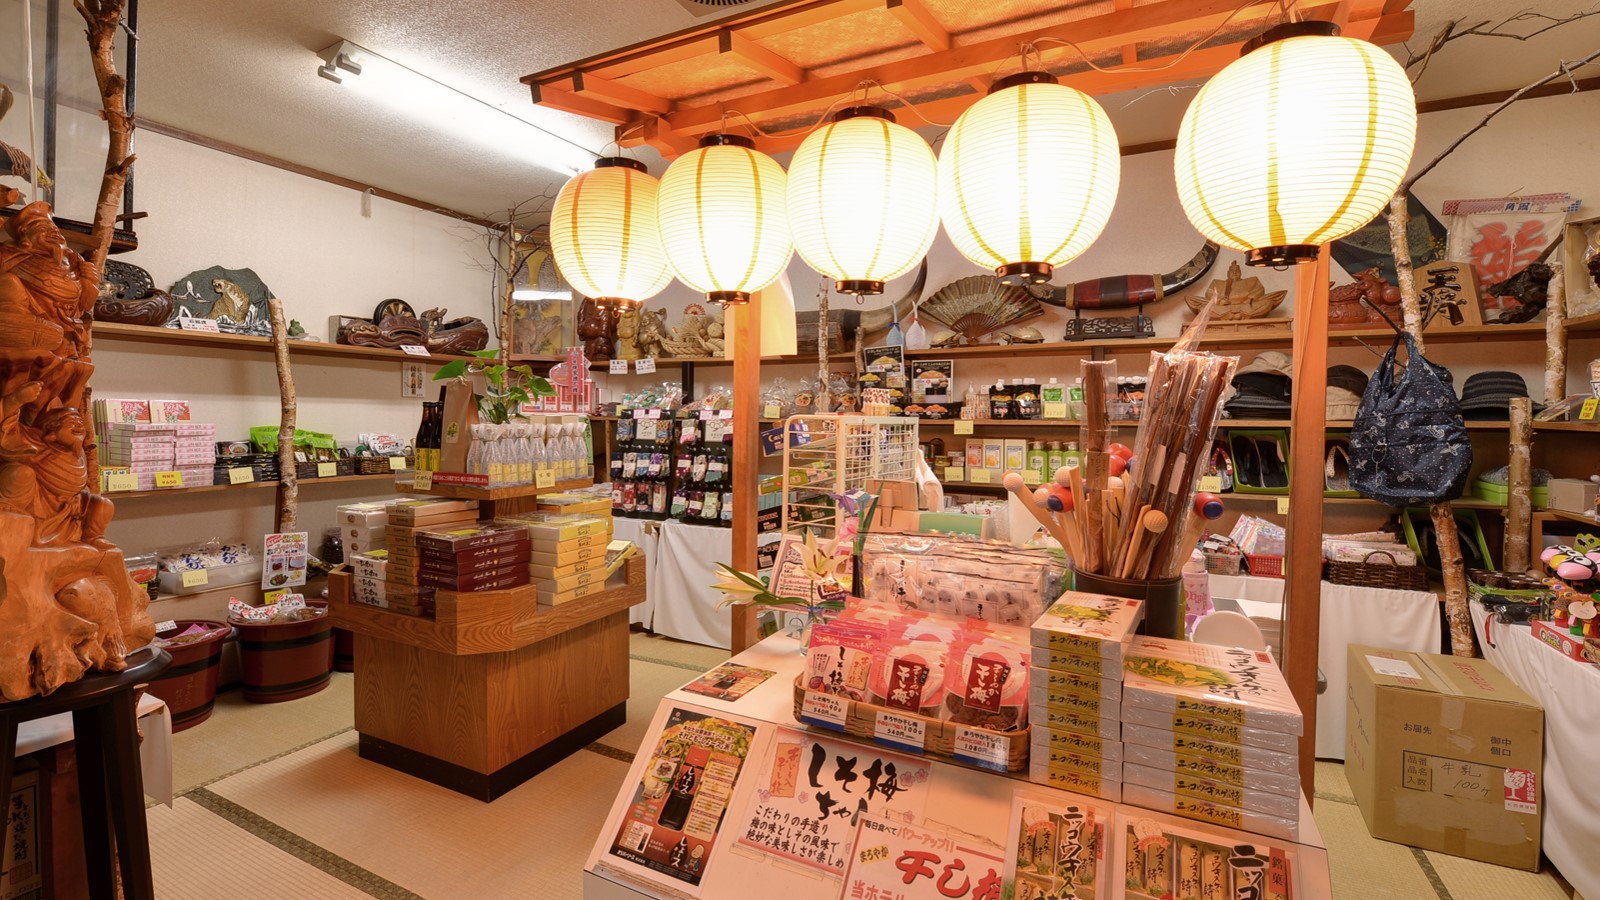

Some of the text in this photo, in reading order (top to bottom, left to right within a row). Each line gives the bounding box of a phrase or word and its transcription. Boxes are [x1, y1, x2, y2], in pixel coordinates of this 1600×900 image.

[891, 665, 910, 705] 干し梅
[970, 663, 990, 704] 干し梅
[1403, 723, 1432, 735] お届先
[1490, 735, 1512, 746] 御中
[1490, 746, 1511, 757] 個口
[808, 742, 908, 803] しそ梅
[1407, 765, 1428, 776] 品名
[1407, 775, 1427, 787] 入数
[755, 804, 828, 835] こだわりの手造り
[865, 819, 898, 835] 毎日食べて
[750, 816, 840, 853] 梅の味としその風味で
[859, 845, 889, 863] まろやか
[1271, 856, 1284, 886] 銘菓
